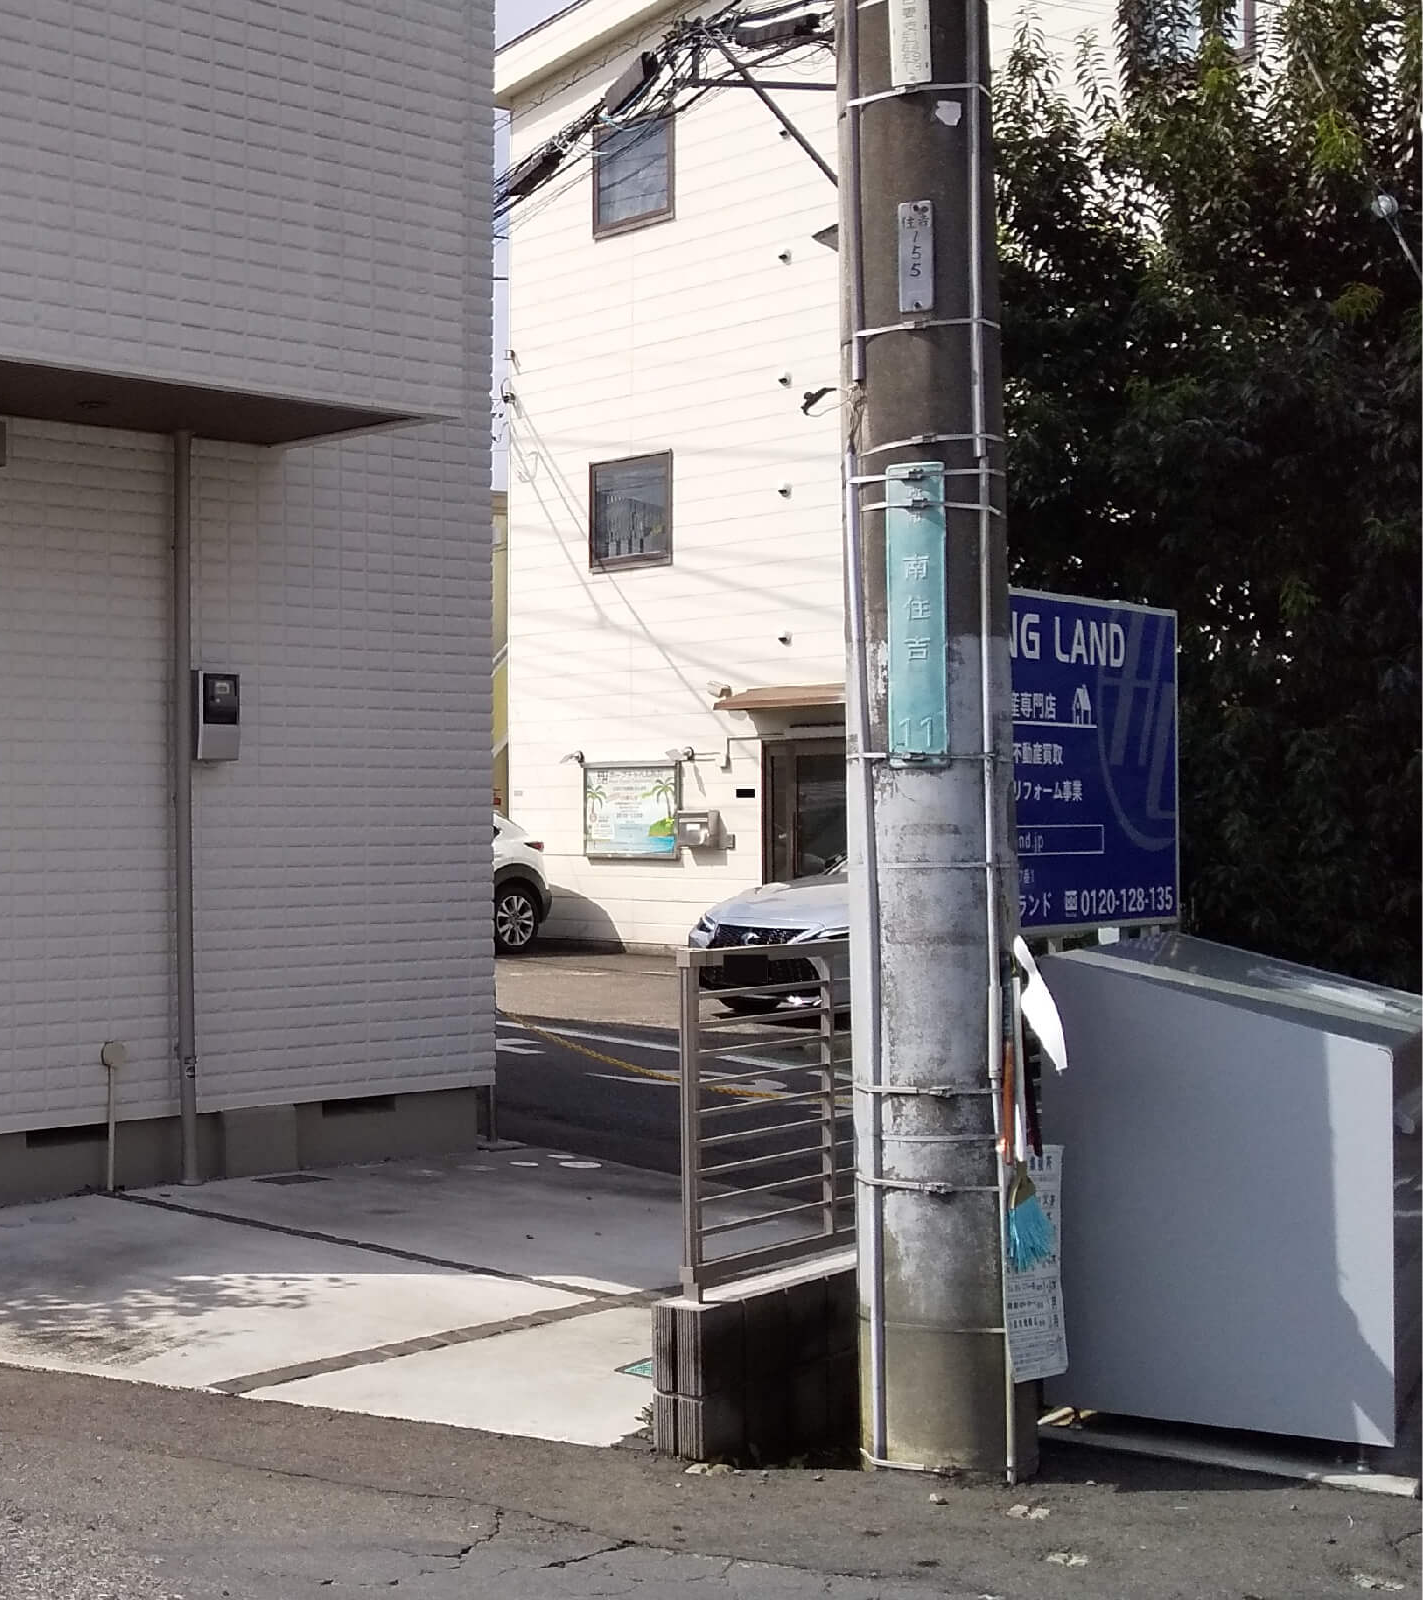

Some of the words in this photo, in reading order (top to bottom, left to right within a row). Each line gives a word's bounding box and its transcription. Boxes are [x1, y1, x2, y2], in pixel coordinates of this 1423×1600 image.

[910, 231, 922, 277] 155
[902, 553, 931, 661] 南住吉
[1054, 615, 1126, 668] LAND
[898, 715, 934, 748] 11
[1018, 892, 1052, 918] ランド
[1081, 886, 1173, 916] 0120-128-135
